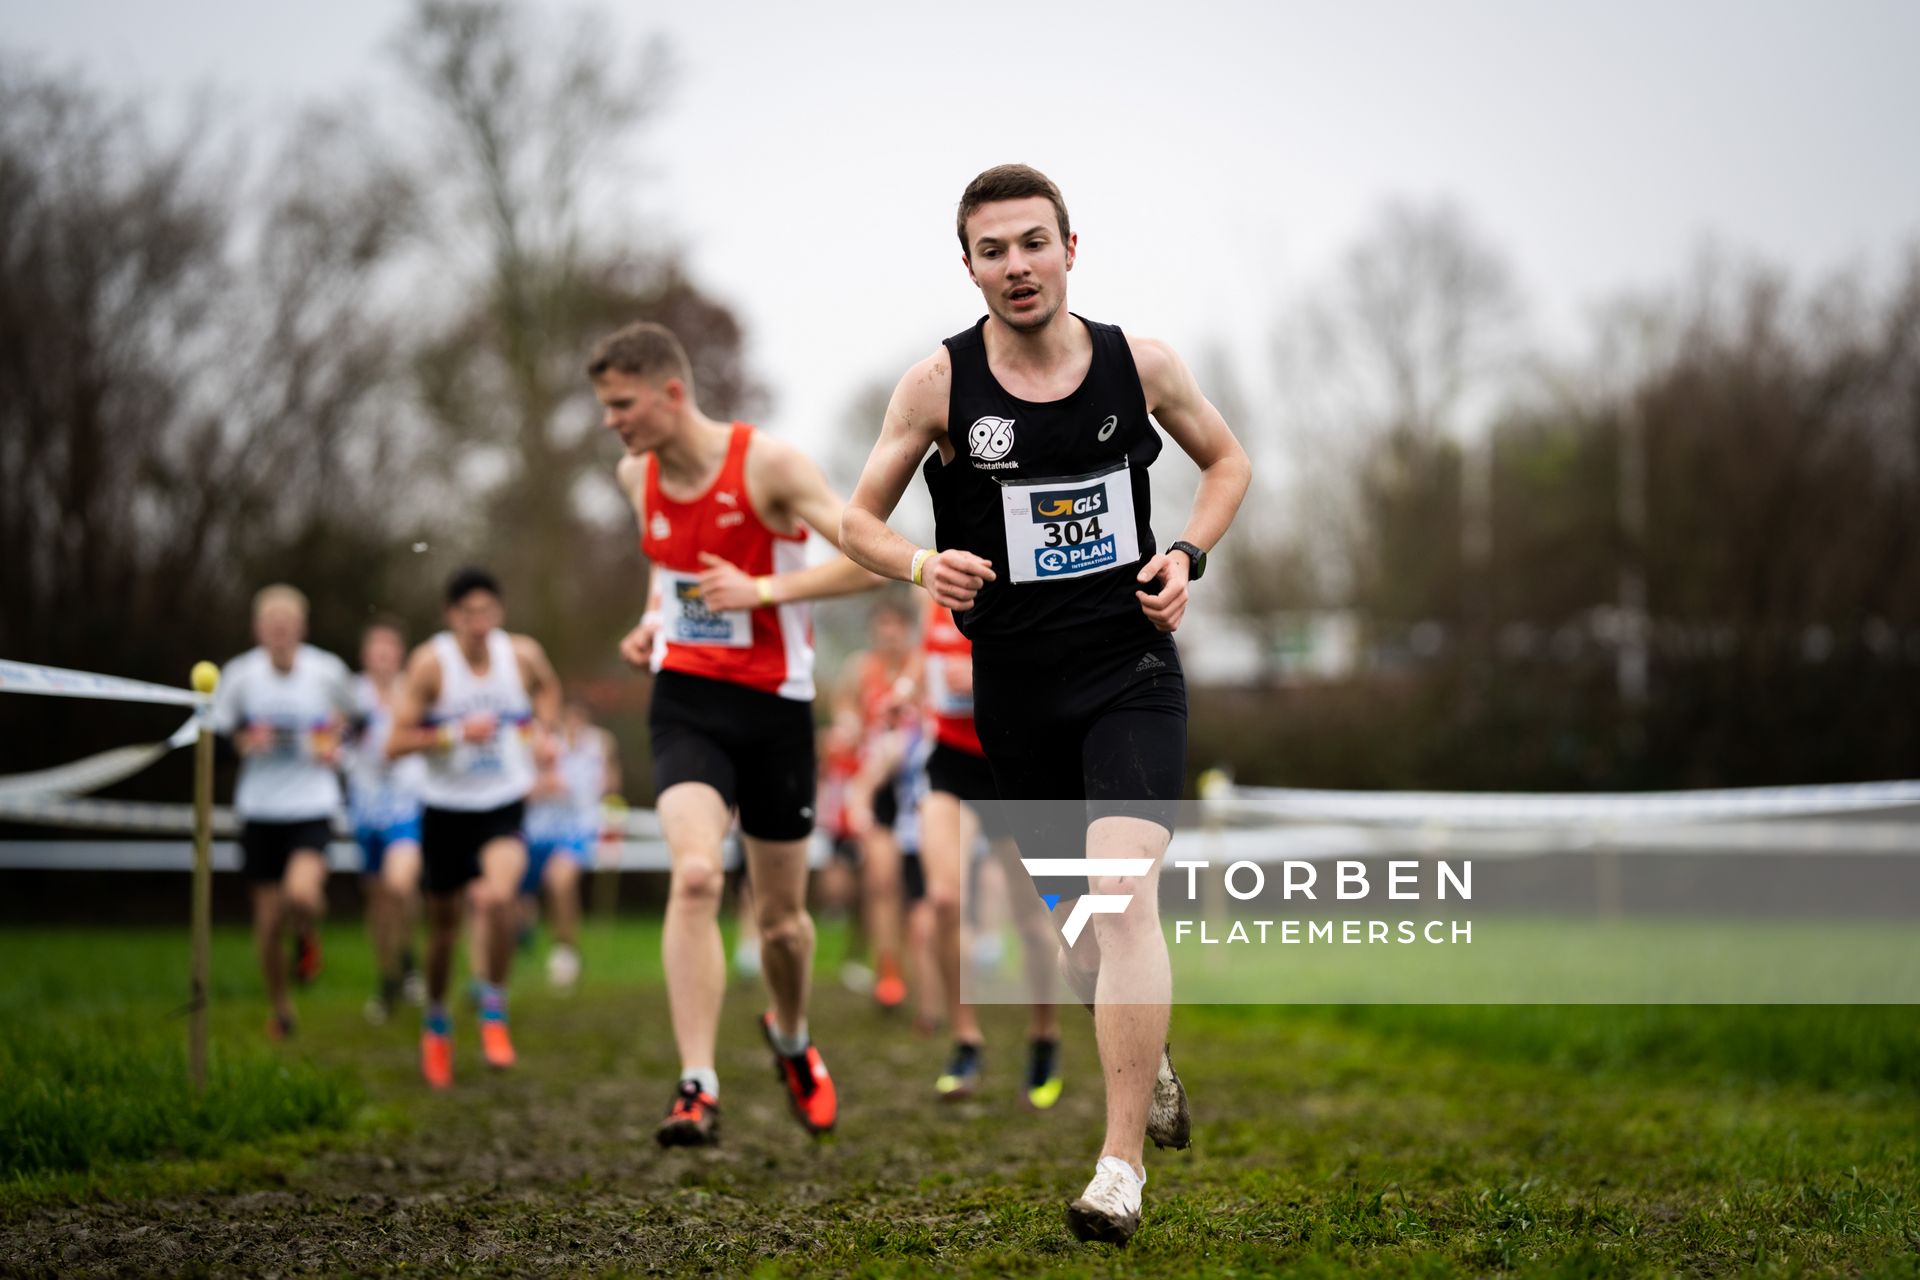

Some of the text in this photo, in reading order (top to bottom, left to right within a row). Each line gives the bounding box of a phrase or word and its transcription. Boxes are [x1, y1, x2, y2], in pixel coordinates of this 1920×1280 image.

[972, 420, 1013, 456] 96
[1073, 493, 1101, 515] GLS
[1043, 516, 1102, 547] 304
[1070, 541, 1113, 563] PLAN
[1071, 555, 1114, 569] INTERNATIONAL
